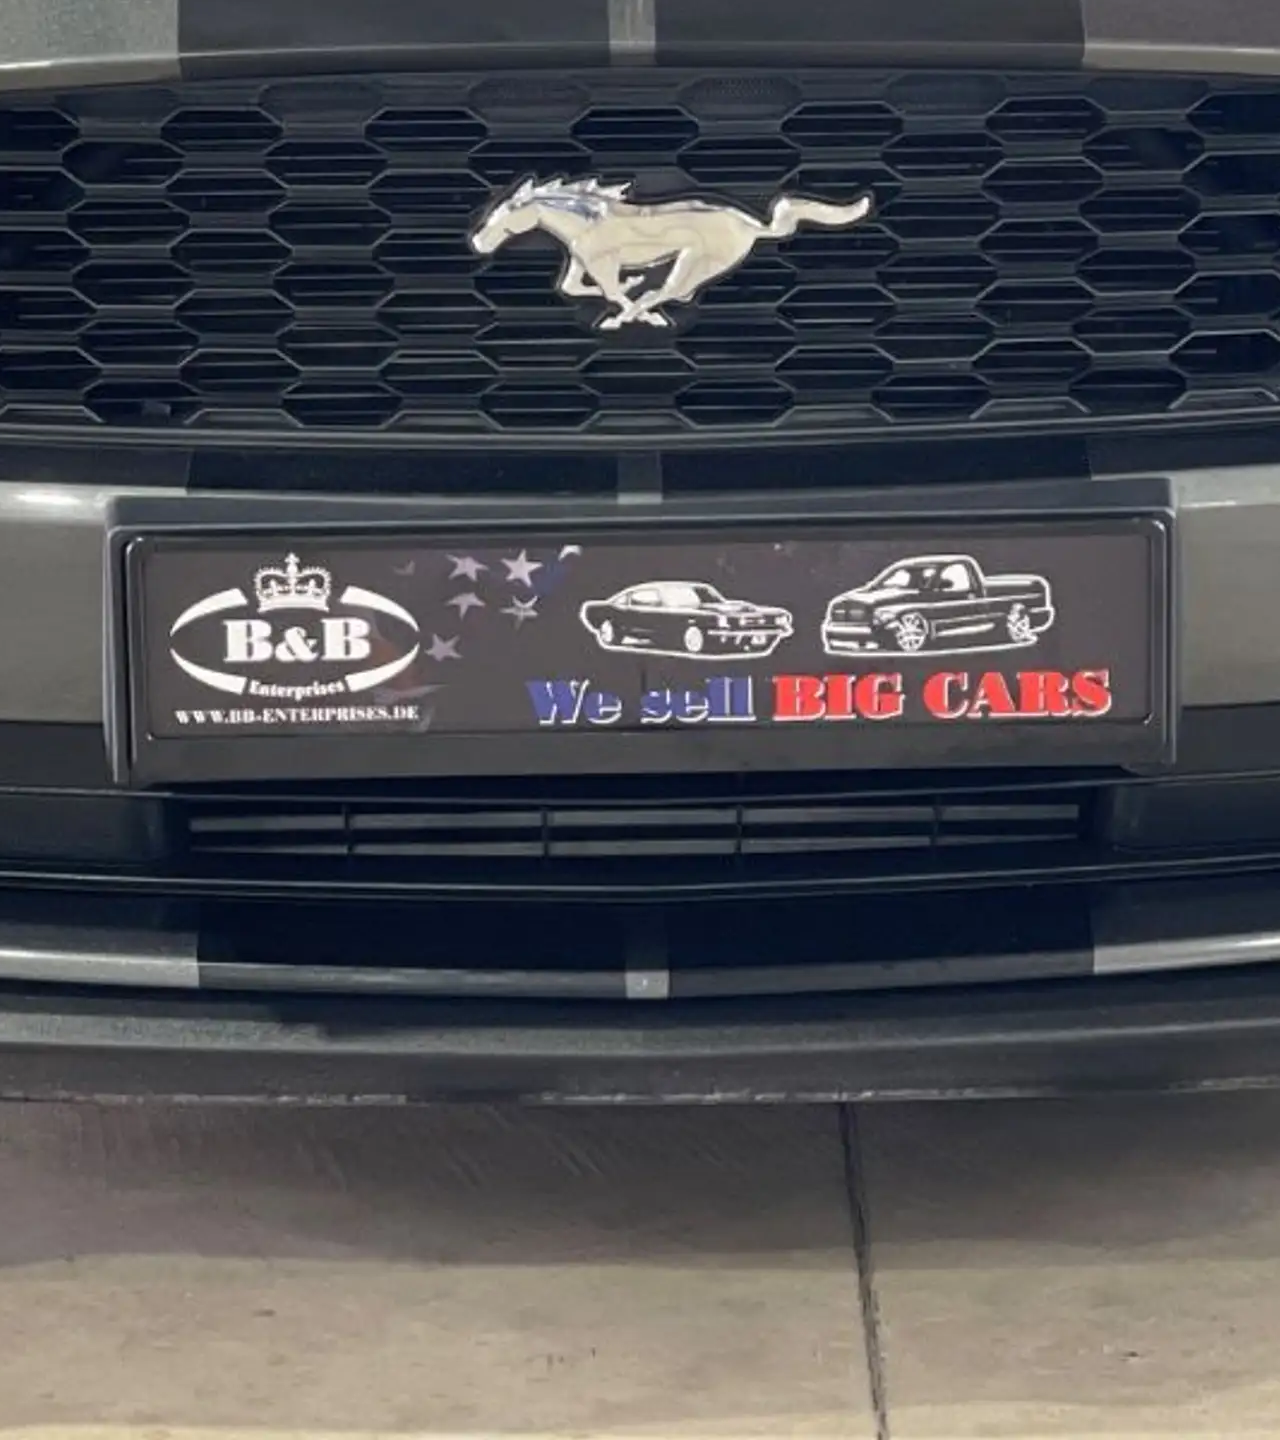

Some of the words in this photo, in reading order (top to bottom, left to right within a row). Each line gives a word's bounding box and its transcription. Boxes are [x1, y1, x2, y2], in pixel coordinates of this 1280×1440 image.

[222, 616, 371, 663] B&B
[248, 679, 345, 701] Enterprises
[526, 675, 622, 724] We
[640, 675, 757, 723] sell
[771, 673, 904, 721] BIG
[923, 668, 1113, 717] CARS
[175, 706, 419, 726] WWW.BB-ENTERPRISES.DE
